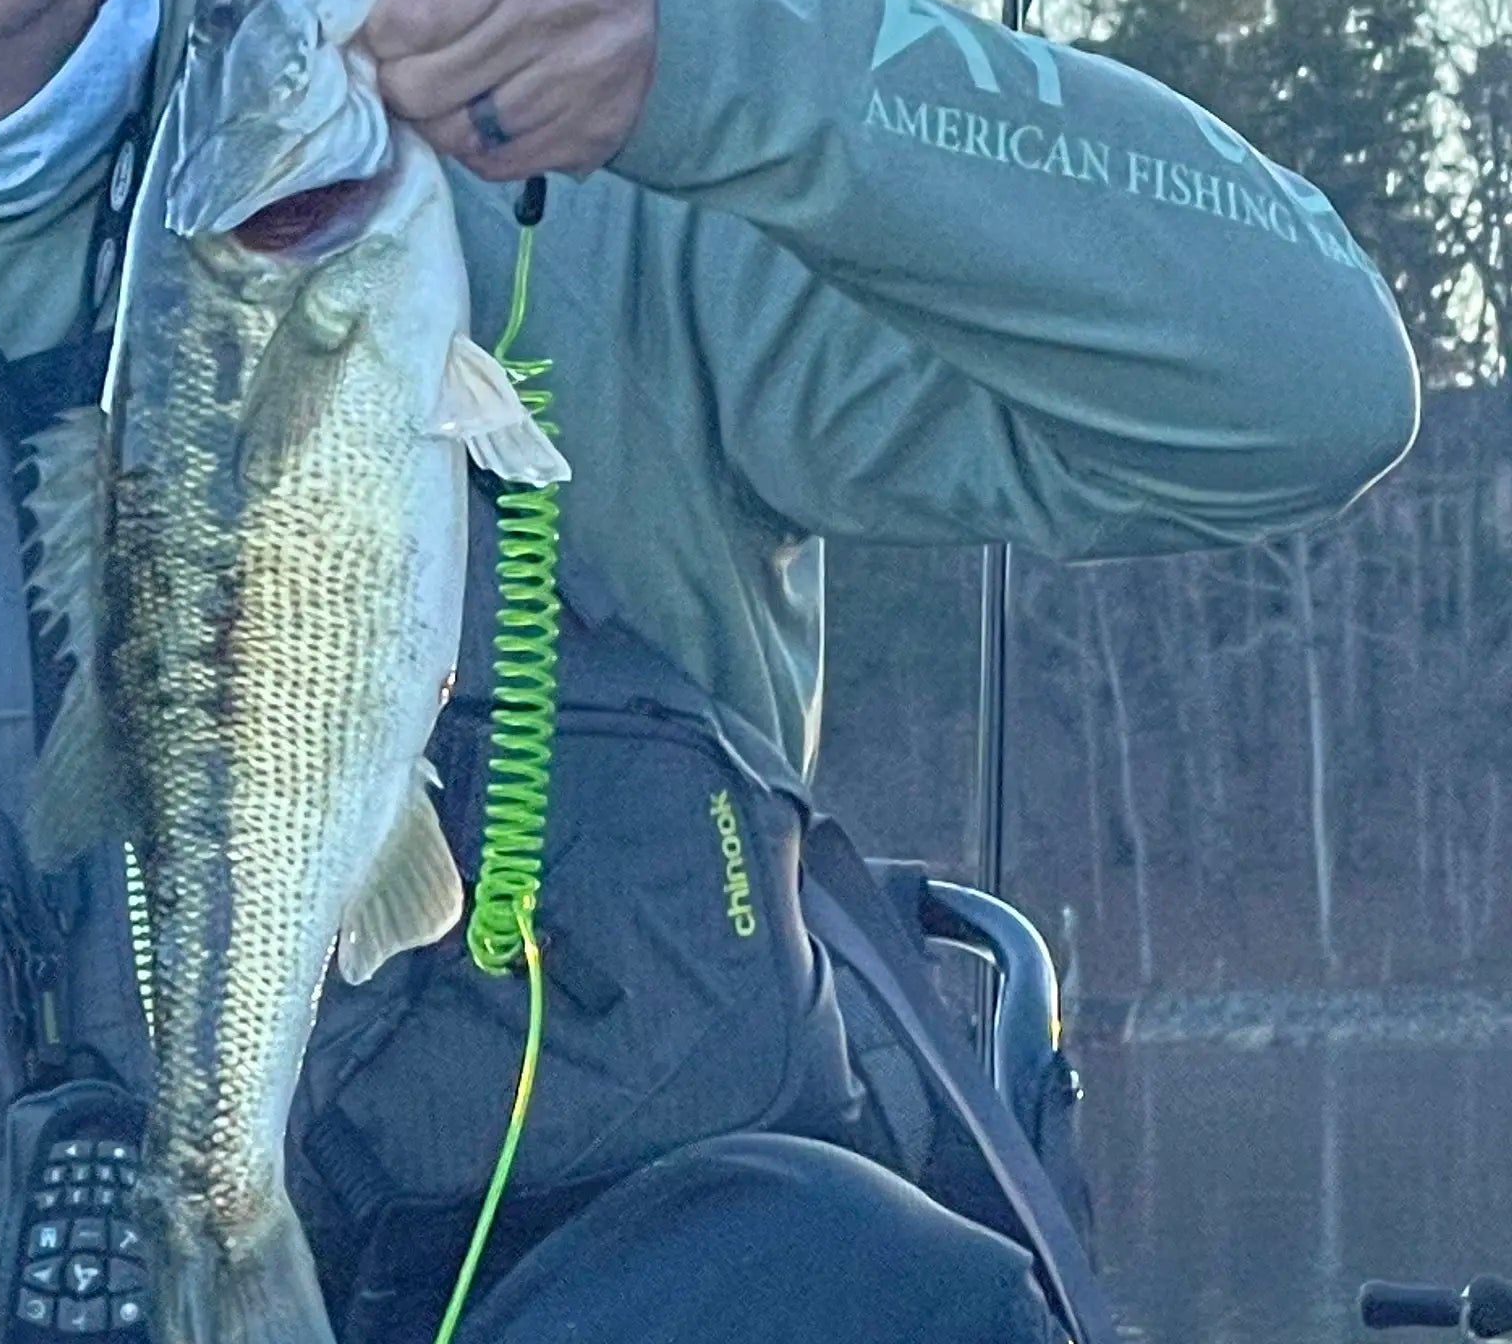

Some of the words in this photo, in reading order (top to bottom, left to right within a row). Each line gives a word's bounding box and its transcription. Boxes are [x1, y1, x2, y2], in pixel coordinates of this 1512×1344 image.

[864, 89, 1110, 188] AMERICAN
[1127, 150, 1297, 243] FISHING
[709, 789, 756, 937] chinook
